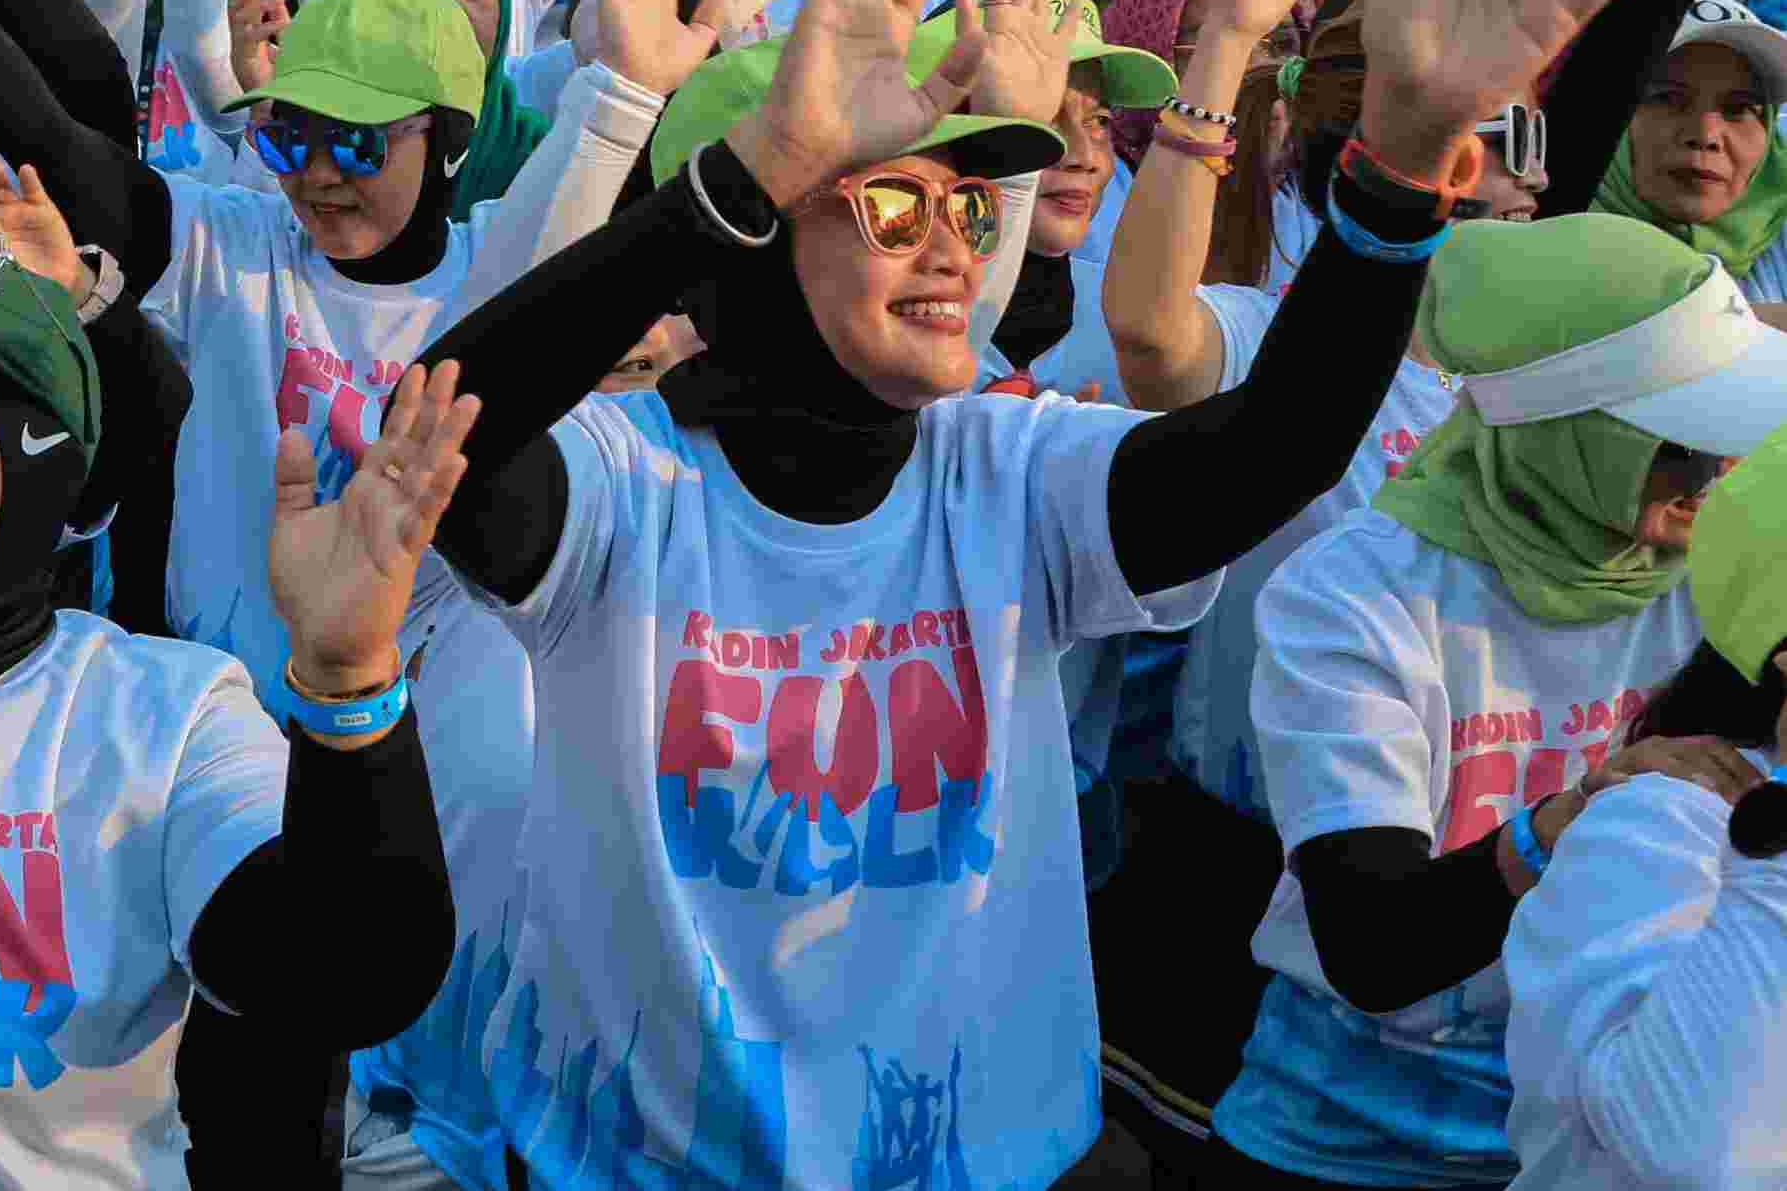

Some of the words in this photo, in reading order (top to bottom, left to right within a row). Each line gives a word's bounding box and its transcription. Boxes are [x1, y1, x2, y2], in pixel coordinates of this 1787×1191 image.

[659, 658, 988, 821] FUN
[1451, 707, 1543, 751] KADIN
[656, 760, 995, 897] WALK
